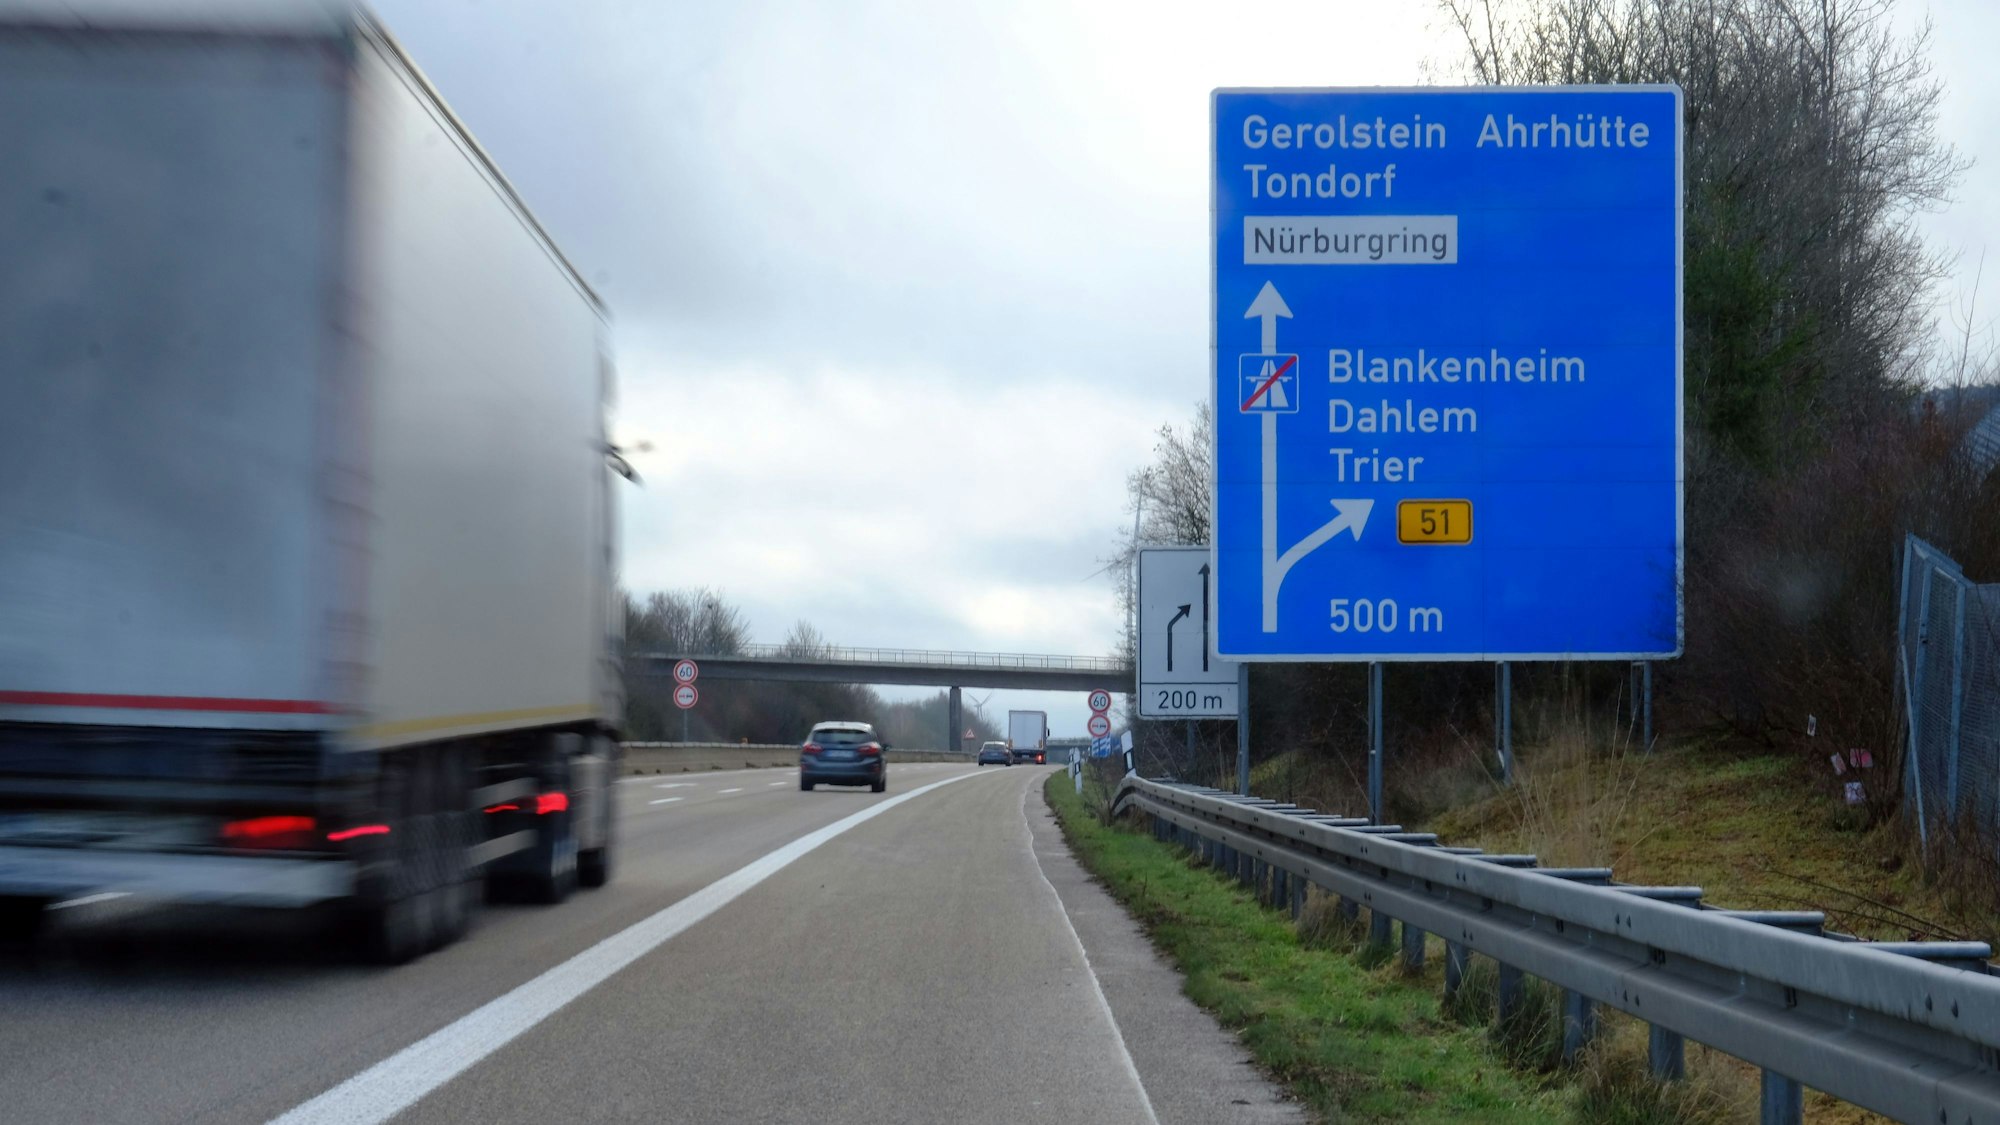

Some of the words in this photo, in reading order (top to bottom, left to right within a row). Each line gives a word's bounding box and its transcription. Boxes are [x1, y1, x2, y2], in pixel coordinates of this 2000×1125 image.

[1243, 114, 1446, 149] Gerolstein
[1476, 113, 1650, 148] Ahrhütte
[1243, 163, 1396, 198] Tondorf
[1253, 227, 1448, 260] Nürburgring
[1329, 348, 1586, 383] Blankenheim
[1329, 399, 1477, 433] Dahlem
[1330, 448, 1424, 482] Trier
[1420, 509, 1450, 535] 51
[1329, 599, 1397, 633] 500
[1409, 607, 1443, 633] m
[679, 666, 692, 677] 60
[1093, 696, 1106, 707] 60
[1158, 690, 1196, 709] 200
[1203, 696, 1222, 709] m
